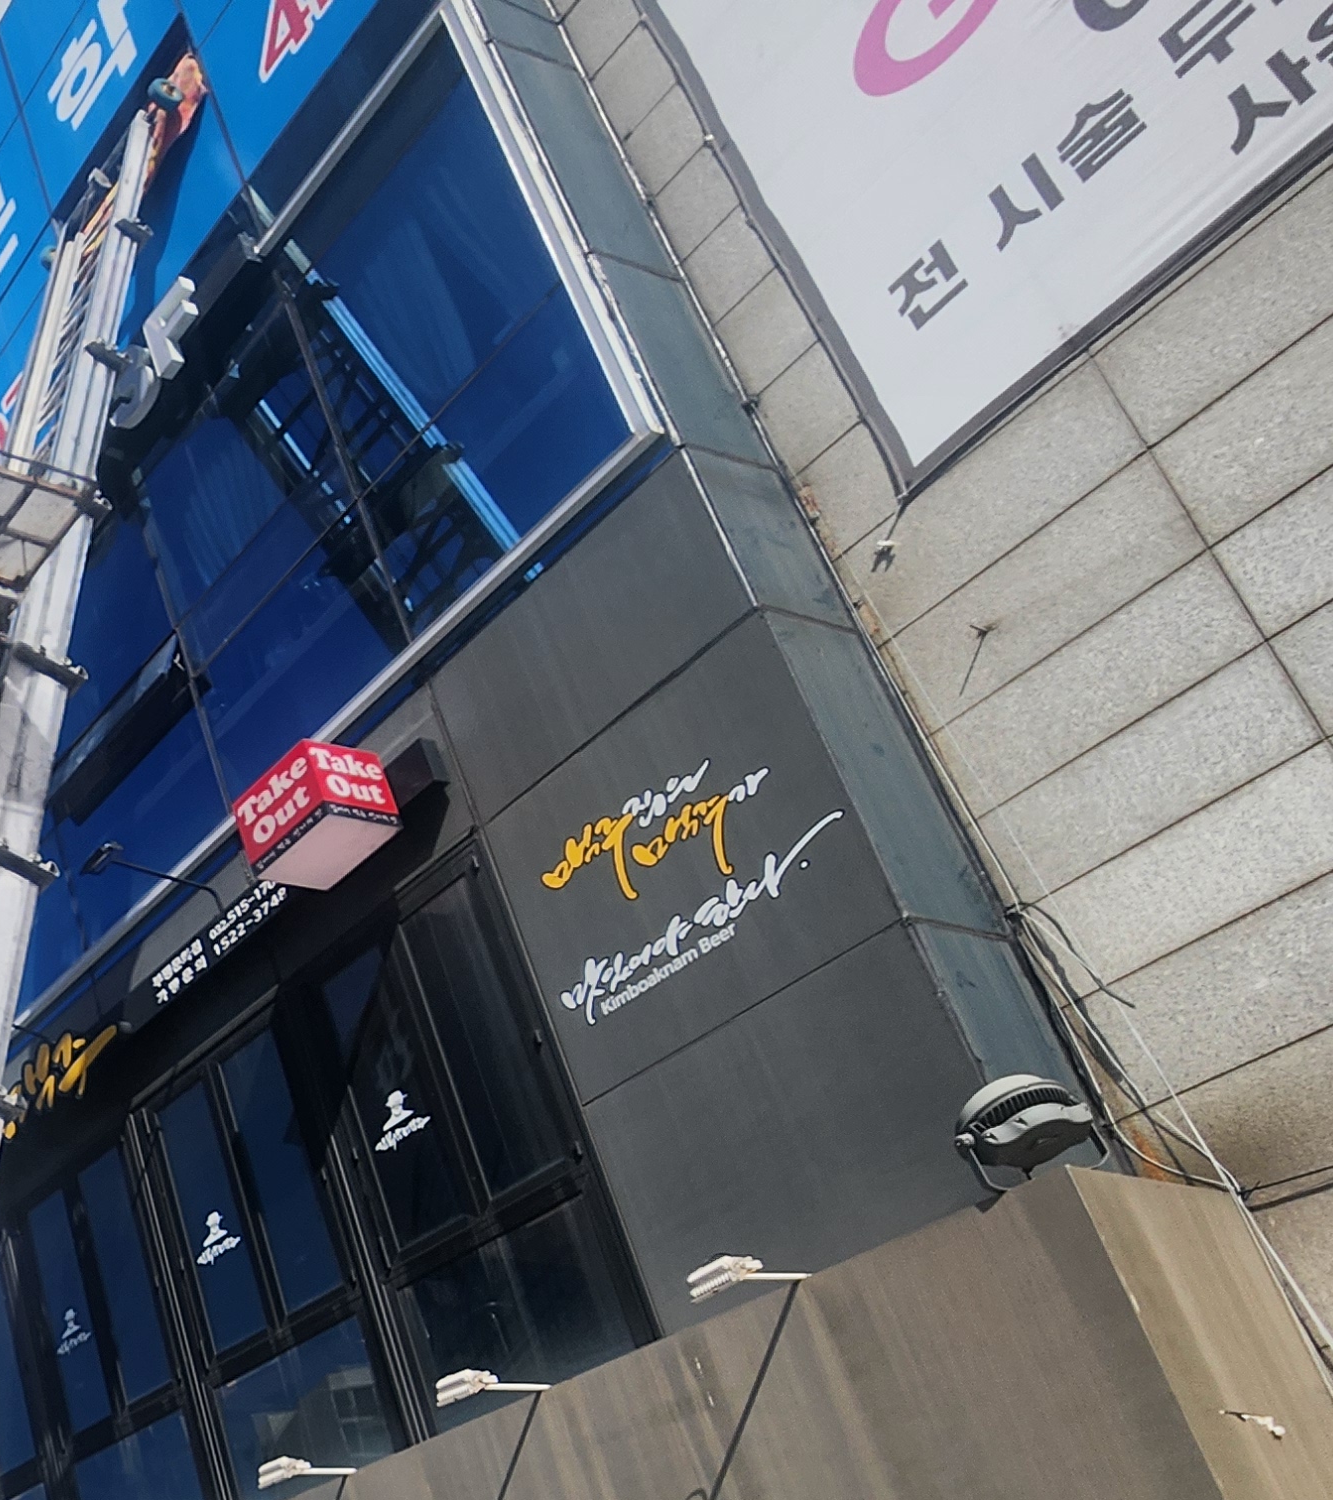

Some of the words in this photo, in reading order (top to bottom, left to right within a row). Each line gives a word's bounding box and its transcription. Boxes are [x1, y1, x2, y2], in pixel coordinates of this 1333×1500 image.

[888, 239, 968, 330] 전
[988, 89, 1147, 253] 시술
[238, 757, 307, 826] Take
[309, 746, 383, 780] Take
[326, 775, 386, 804] Out
[253, 786, 310, 844] Out
[600, 947, 699, 1016] Kimboaknam
[697, 922, 737, 955] Beer
